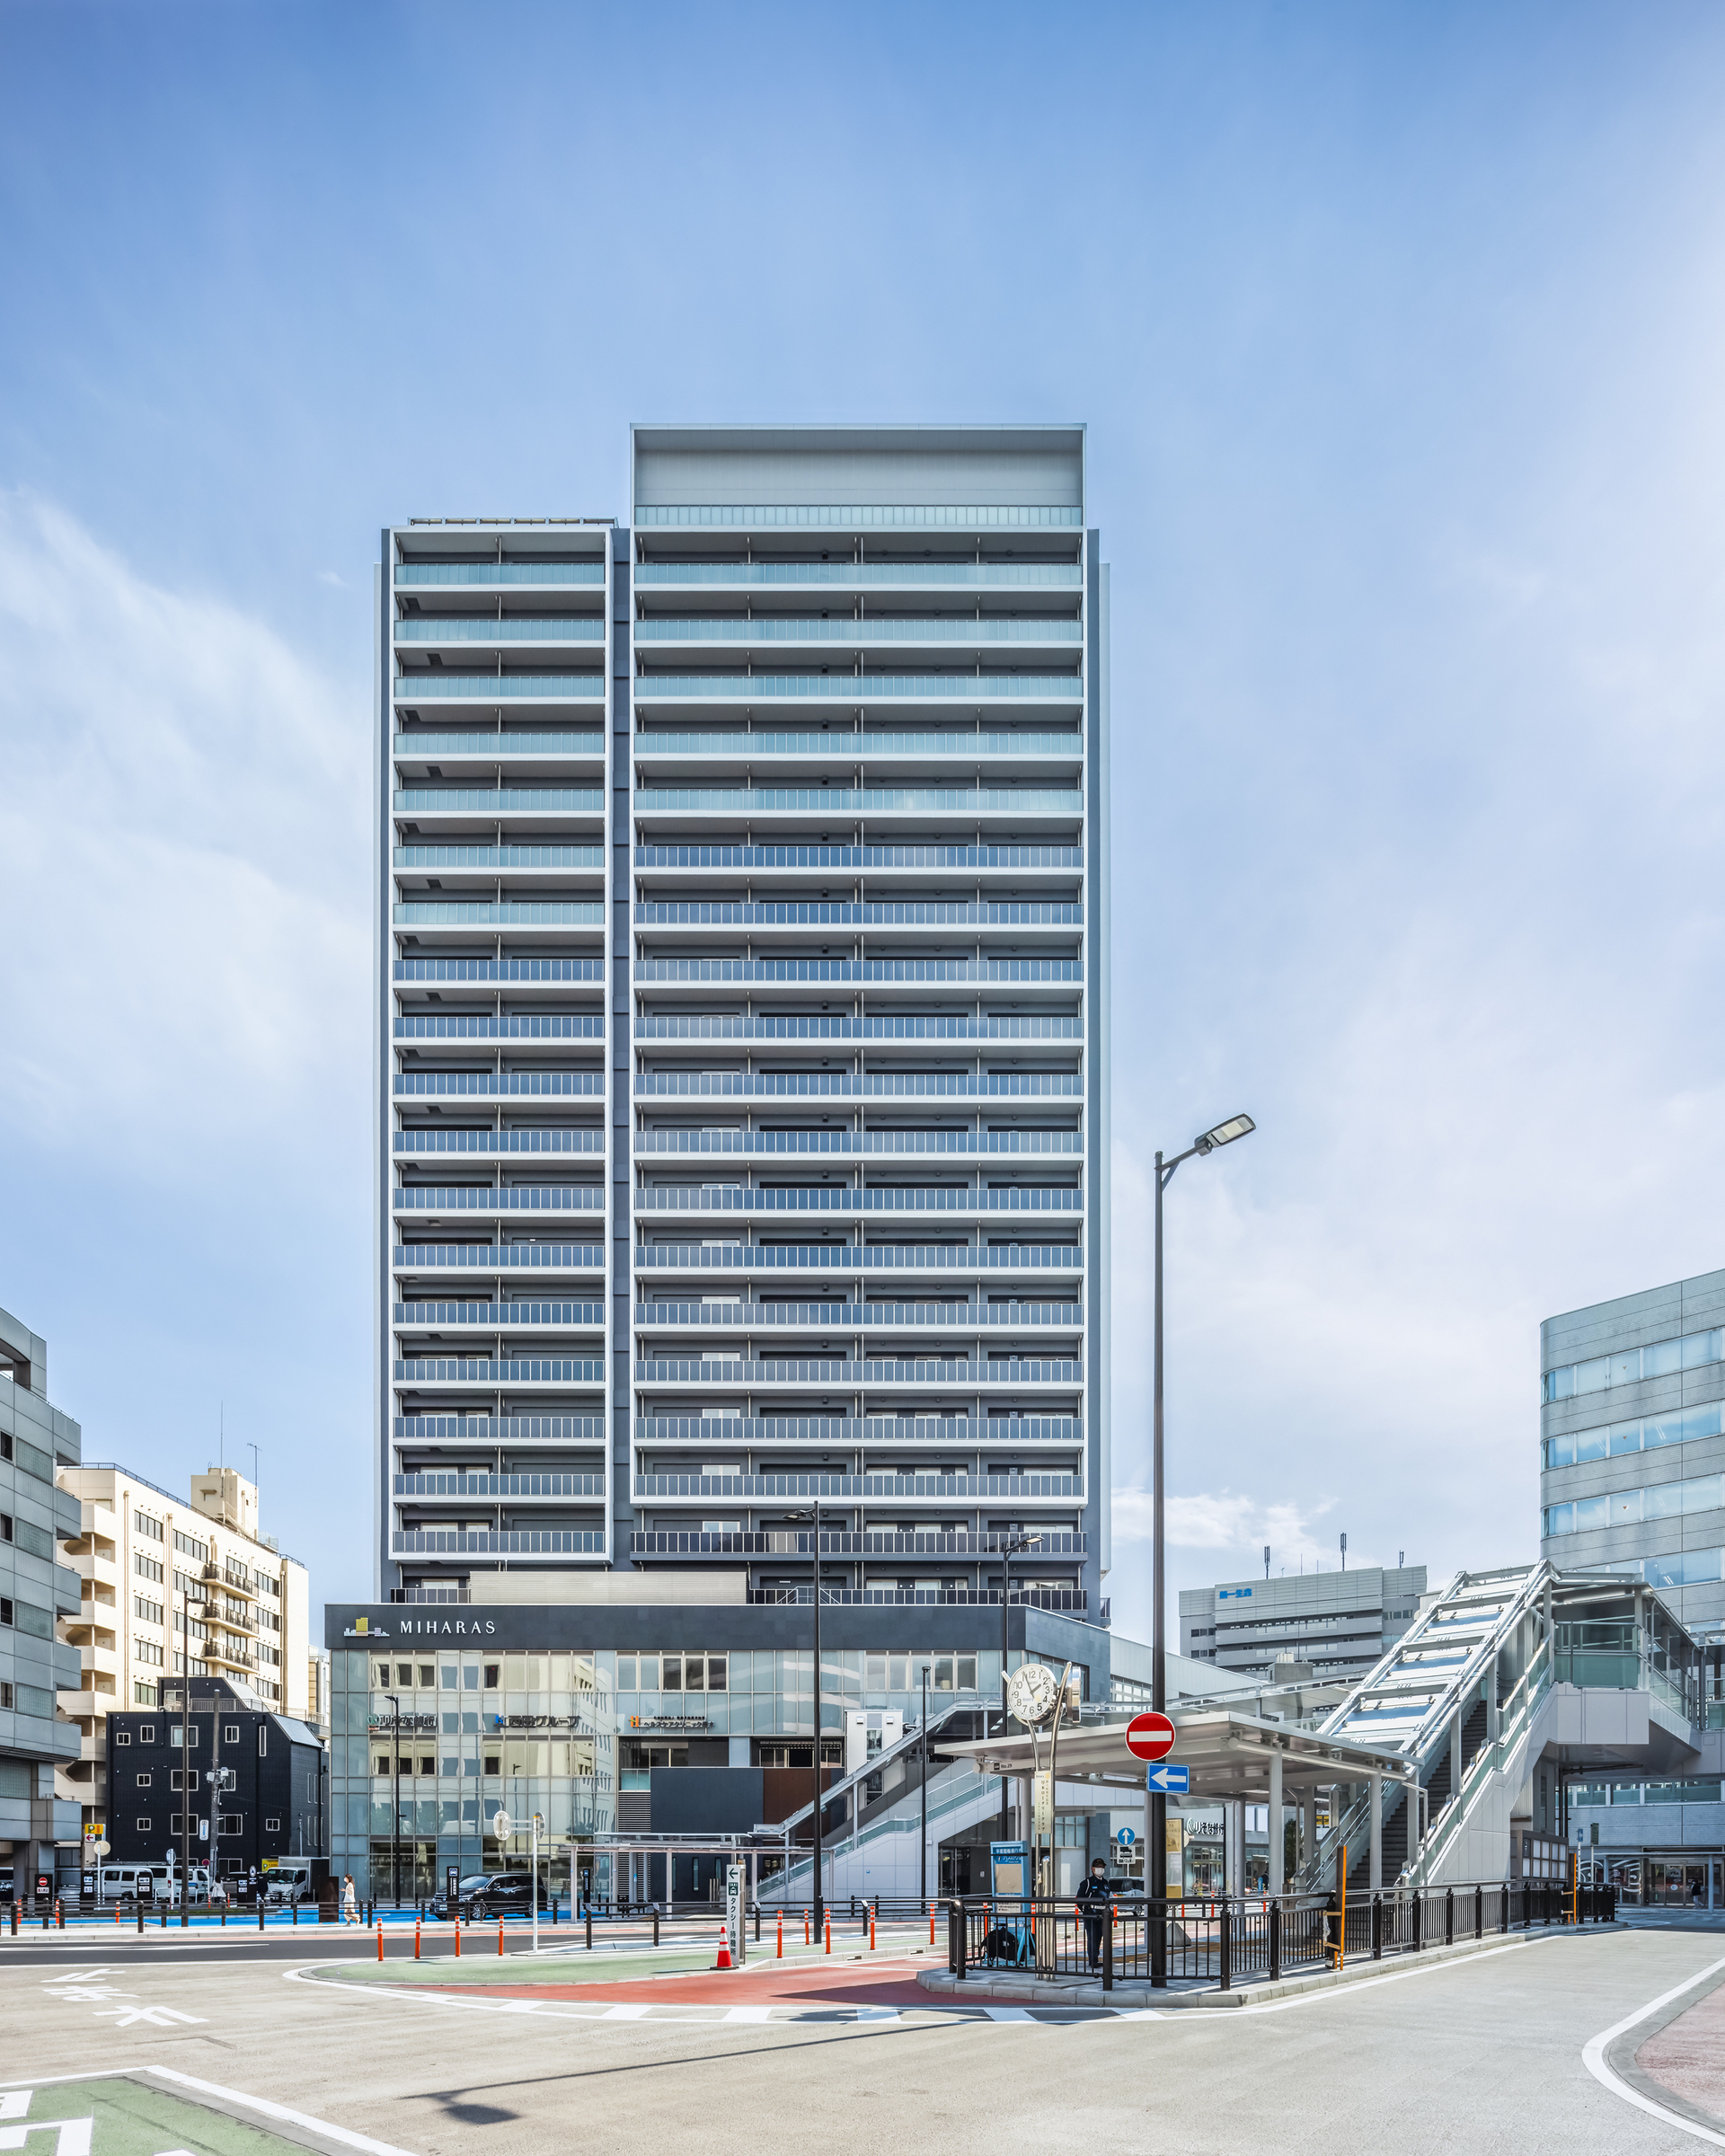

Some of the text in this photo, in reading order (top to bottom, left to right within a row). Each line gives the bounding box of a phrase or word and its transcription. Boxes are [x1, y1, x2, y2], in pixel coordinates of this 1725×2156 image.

[400, 1621, 496, 1634] MIHARAS
[1029, 1671, 1036, 1679] 12
[1043, 1677, 1048, 1685] 2
[1045, 1686, 1050, 1694] 3
[1013, 1691, 1020, 1699] 9
[1017, 1699, 1022, 1707] 8
